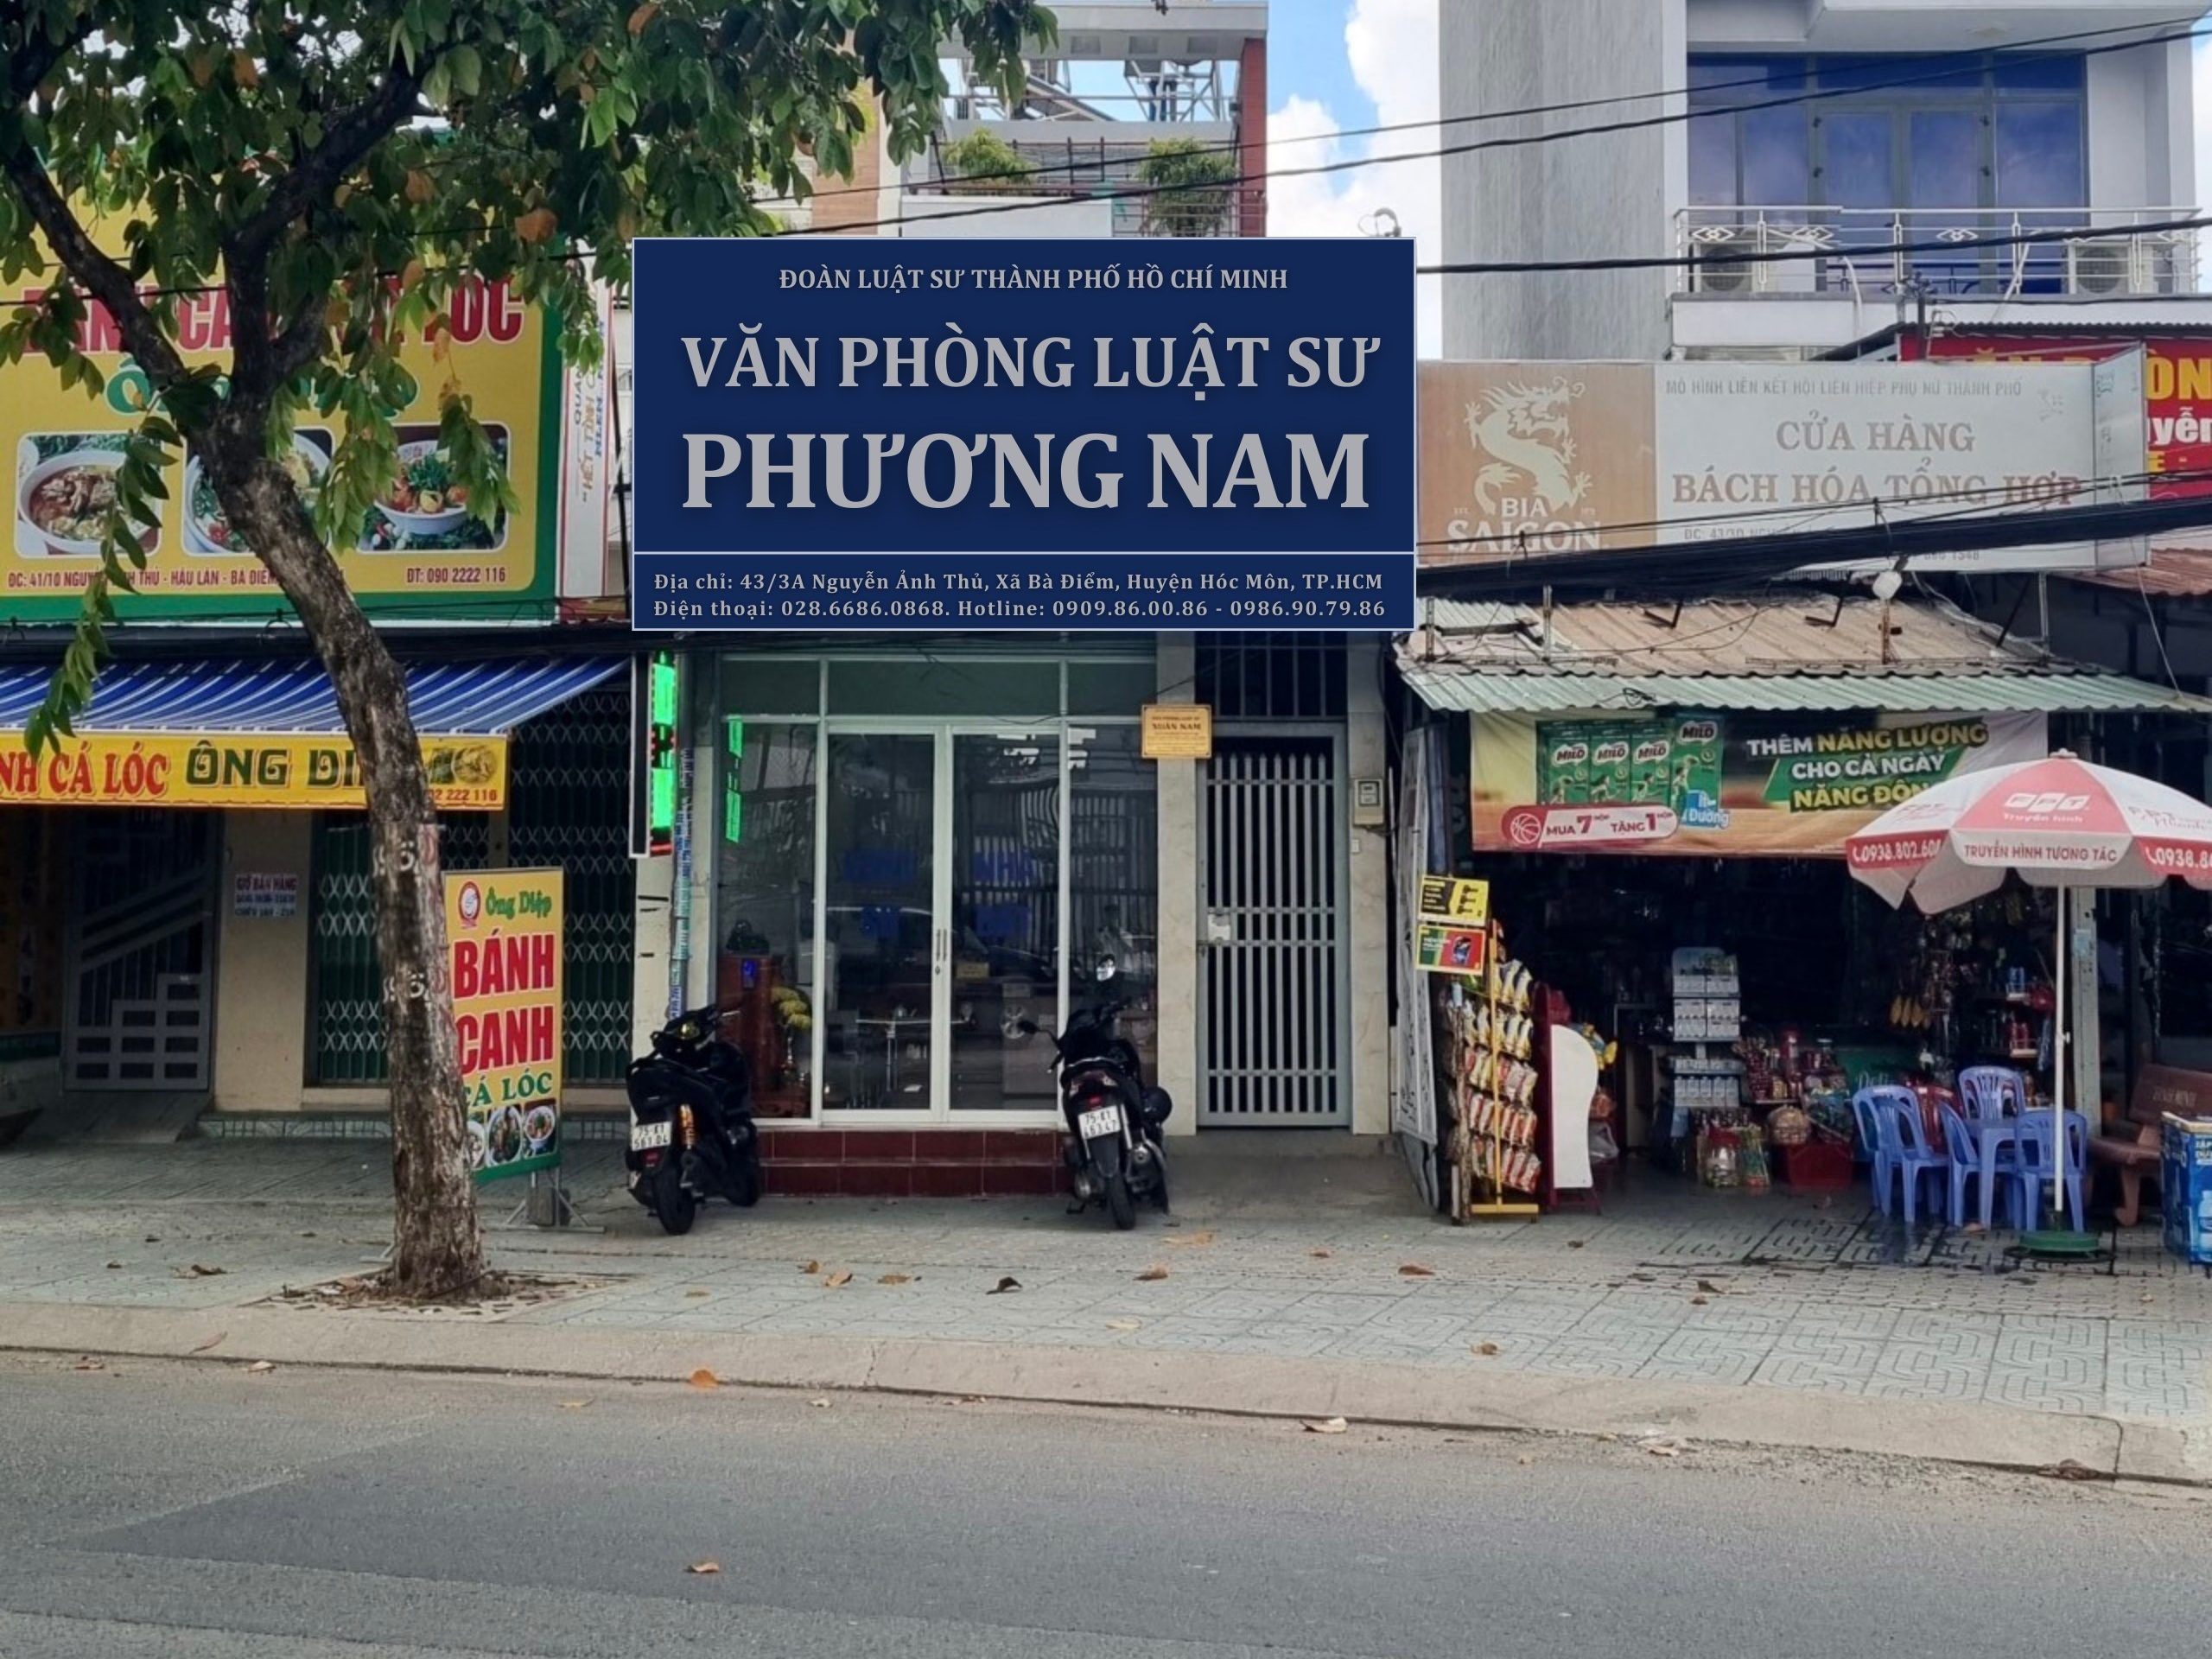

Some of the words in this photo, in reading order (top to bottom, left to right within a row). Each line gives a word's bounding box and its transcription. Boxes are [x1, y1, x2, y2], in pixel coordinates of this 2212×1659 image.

[779, 264, 850, 288] ĐOÀN
[858, 264, 923, 293] LUẬT
[931, 269, 965, 288] SƯ
[971, 264, 1060, 288] THÀNH
[1068, 264, 1121, 288] PHỐ
[1128, 264, 1163, 288] HỒ
[1172, 264, 1212, 288] CHÍ
[1221, 270, 1287, 288] MINH
[681, 323, 818, 387] VĂN
[839, 322, 1074, 388] PHÒNG
[1094, 323, 1268, 400] LUẬT
[1287, 336, 1381, 388] SƯ
[1776, 410, 1855, 451] CỬA
[1867, 415, 1976, 452] HÀNG
[683, 433, 1123, 508] PHƯƠNG
[1147, 433, 1369, 508] NAM
[1673, 466, 1778, 503] BÁCH
[1791, 466, 1871, 503] HÓA
[1885, 456, 1987, 505] TỔNG
[2003, 470, 2082, 506] HỢP
[1501, 497, 1548, 517] BIA
[1446, 519, 1601, 552] SAIGON
[427, 568, 448, 583] 090
[452, 567, 481, 583] 2222
[486, 567, 506, 582] 116
[654, 575, 688, 593] Địa
[696, 573, 732, 588] chỉ:
[741, 574, 804, 593] 43/3A
[813, 571, 888, 594] Nguyễn
[895, 570, 936, 588] Ảnh
[944, 573, 989, 592] Thủ,
[996, 574, 1020, 588] Xã
[1028, 574, 1052, 588] Bà
[1060, 572, 1120, 592] Điểm,
[1128, 574, 1192, 594] Huyện
[1201, 574, 1238, 588] Hóc
[1246, 574, 1295, 592] Môn,
[1302, 575, 1382, 588] TP.HCM
[654, 601, 702, 620] Điện
[711, 601, 772, 620] thoại:
[782, 601, 950, 616] 028.6686.0868.
[958, 601, 1043, 616] Hotline:
[1053, 601, 1207, 616] 0909.86.00.86
[1231, 601, 1384, 616] 0986.90.79.86
[1682, 726, 1715, 739] MILO
[1746, 734, 1813, 756] THÊM
[1817, 728, 1892, 752] NĂNG
[1897, 722, 1987, 753] LƯỢNG
[1557, 747, 1586, 761] MILO
[1598, 747, 1626, 760] MILO
[1638, 746, 1667, 759] MILO
[1791, 760, 1842, 779] CHO
[1845, 756, 1878, 776] CẢ
[1882, 751, 1945, 774] NGÀY
[48, 741, 94, 794] CÁ
[103, 741, 169, 796] LÓC
[186, 739, 289, 785] ÔNG
[307, 748, 365, 786] DI
[1793, 783, 1868, 809] NĂNG
[2004, 792, 2090, 812] FPT
[1546, 824, 1576, 836] MUA
[1576, 815, 1593, 834] 7
[1645, 813, 1656, 831] 1
[1964, 841, 2009, 859] TRUYỀN
[2012, 842, 2042, 860] HÌNH
[2046, 846, 2088, 861] TƯƠNG
[2094, 846, 2117, 862] TÁC
[486, 887, 516, 919] Ông
[454, 928, 555, 999] BÁNH
[456, 1006, 555, 1076] CANH
[502, 1068, 553, 1102] LÓC
